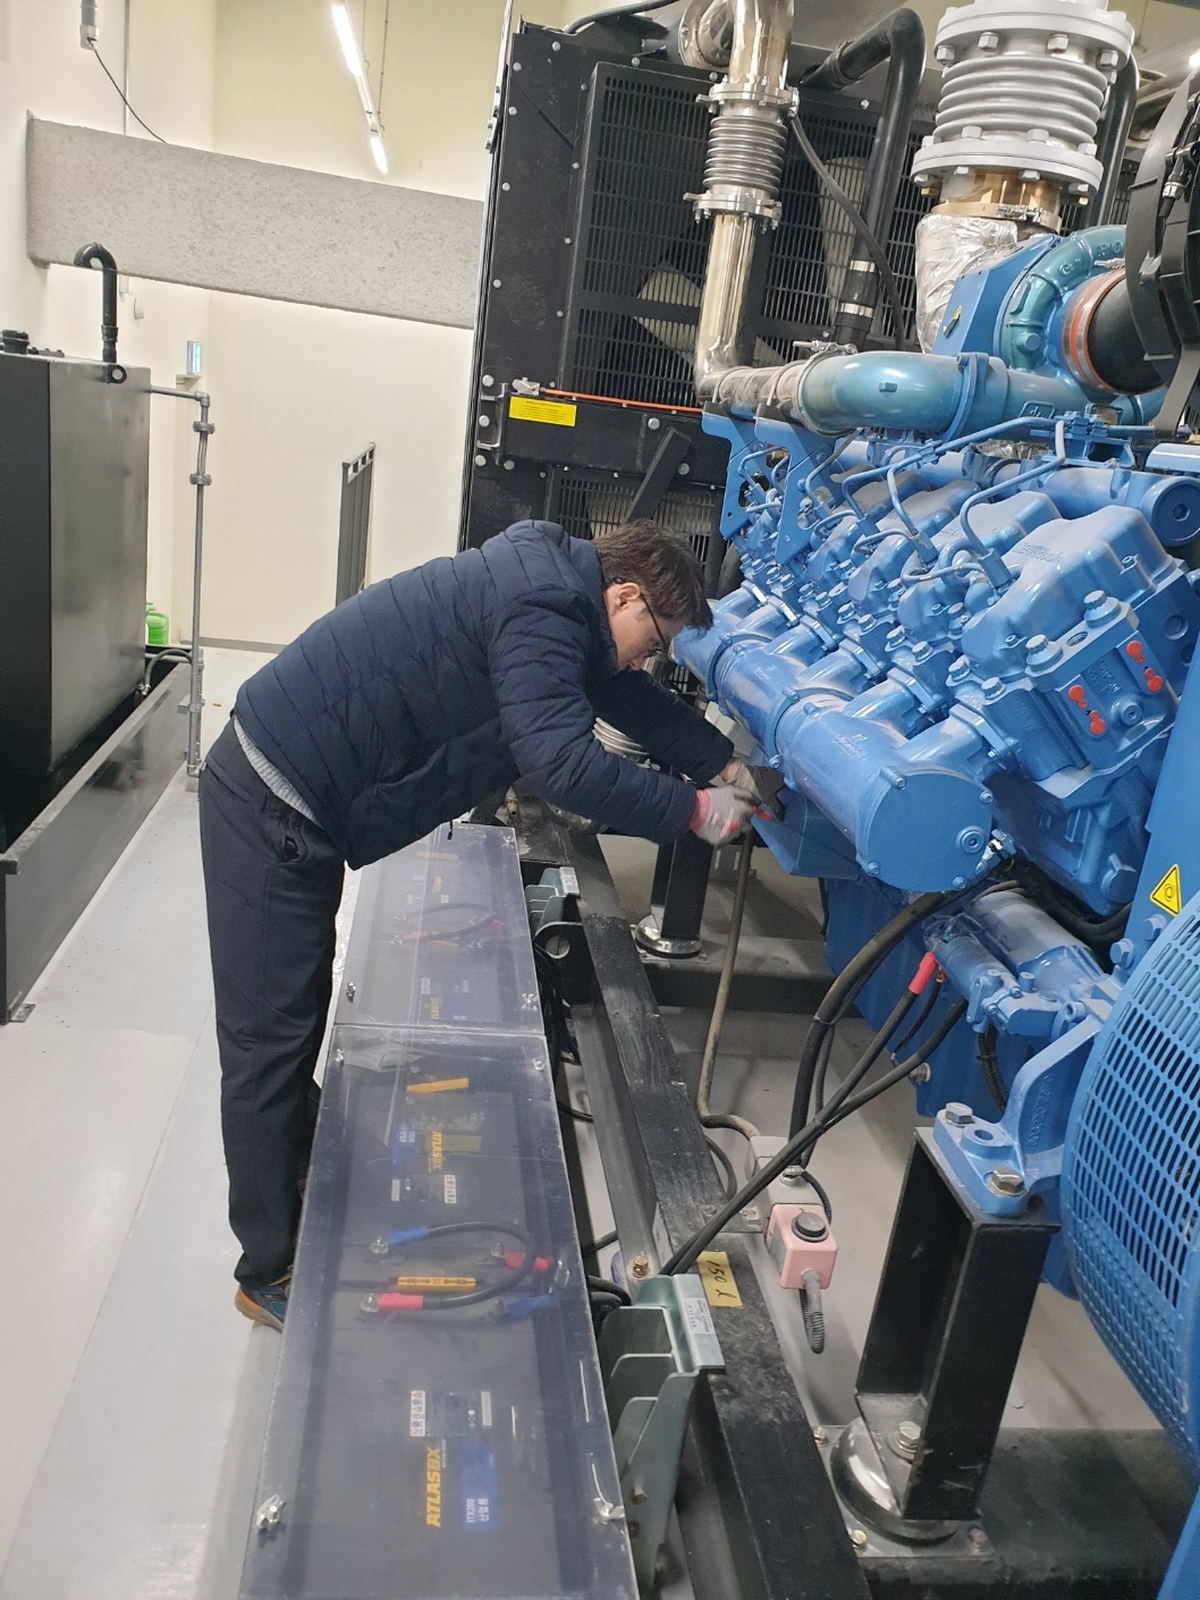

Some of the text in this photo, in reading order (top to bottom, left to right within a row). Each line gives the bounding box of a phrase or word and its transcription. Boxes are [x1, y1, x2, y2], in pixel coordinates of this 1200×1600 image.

[431, 1131, 443, 1169] ATLASBX
[706, 1260, 727, 1283] 150
[426, 1446, 441, 1528] ATLASBX
